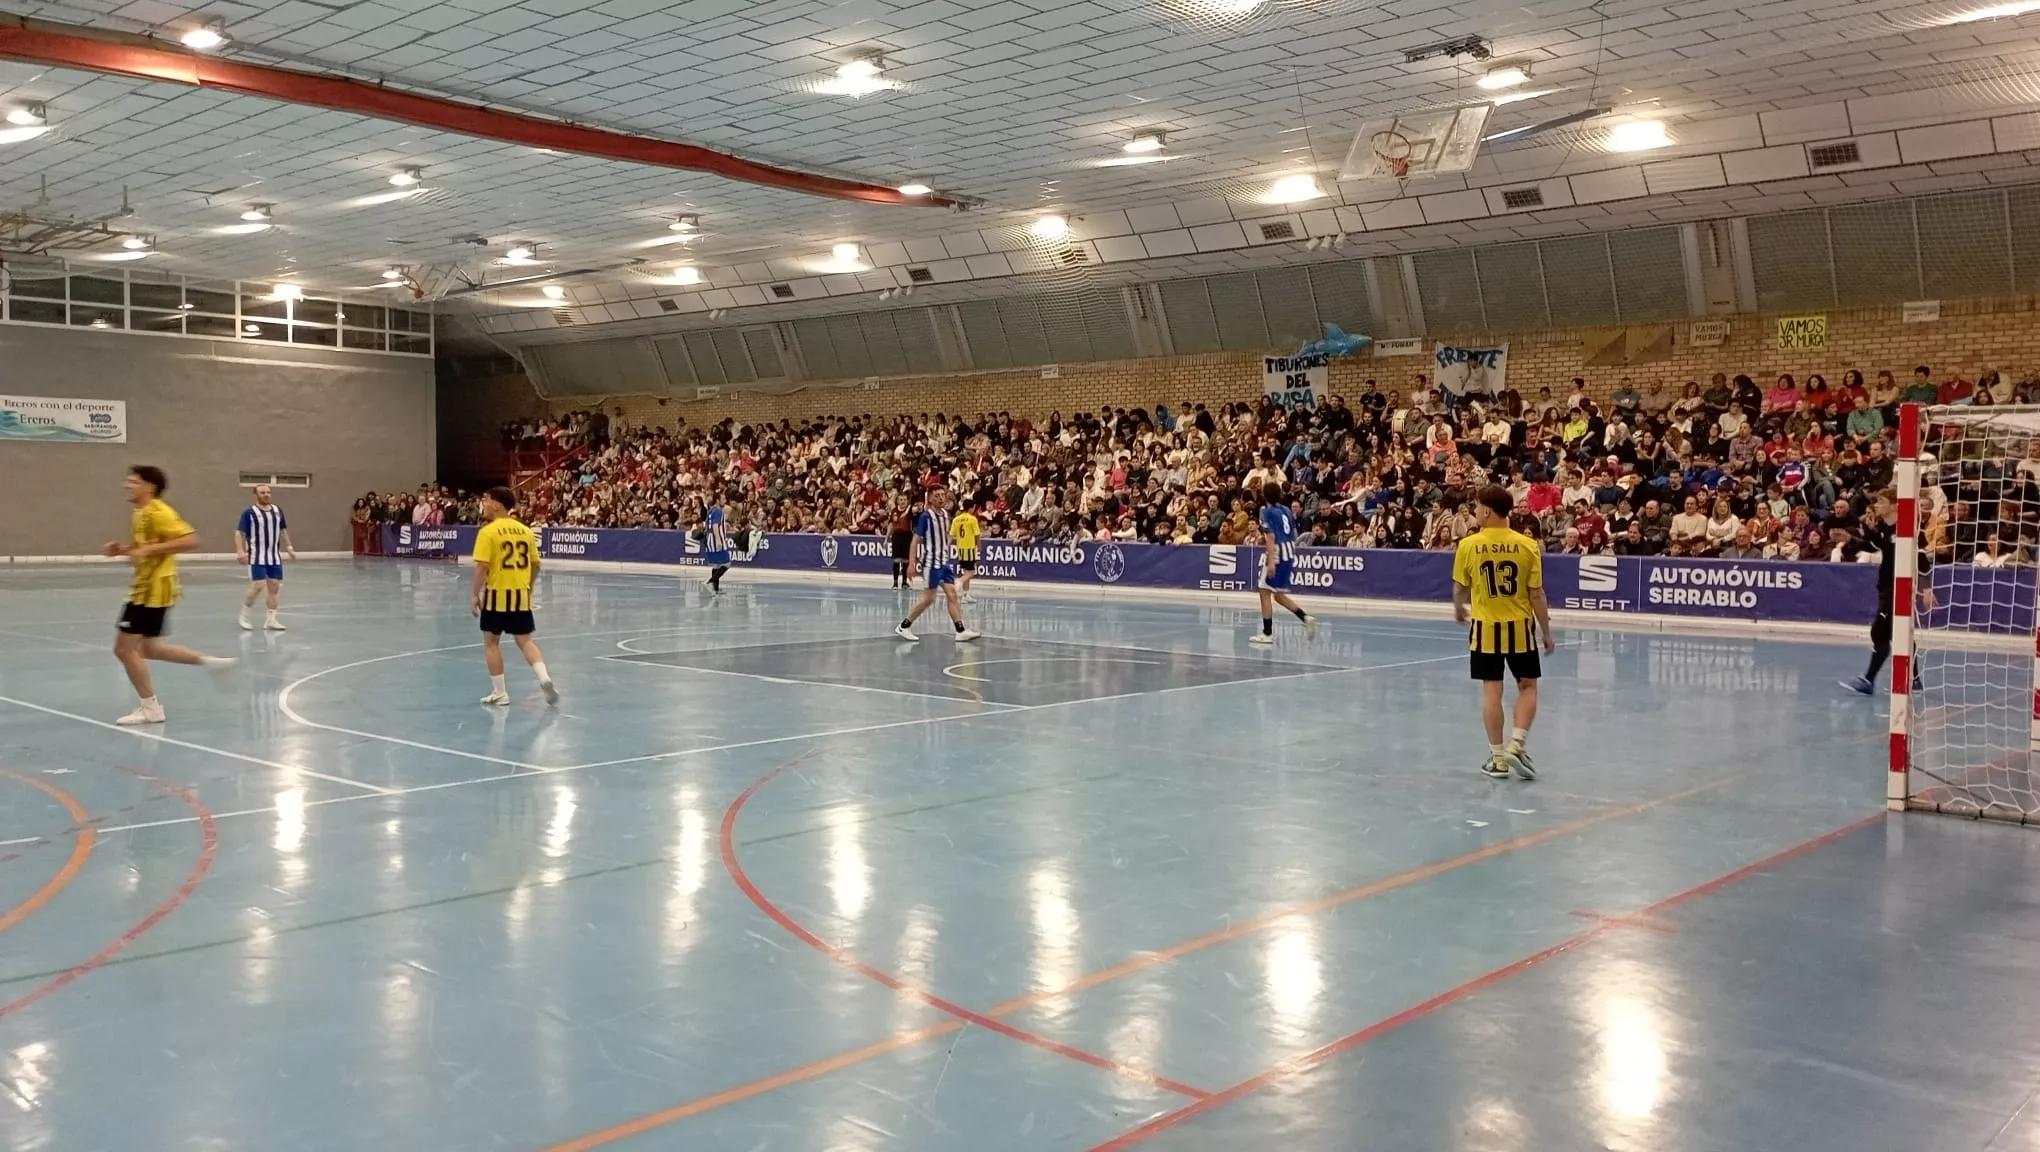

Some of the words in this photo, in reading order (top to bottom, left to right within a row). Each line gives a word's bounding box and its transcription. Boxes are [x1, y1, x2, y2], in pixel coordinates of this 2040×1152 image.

[1780, 319, 1824, 335] VAMOS
[1286, 372, 1310, 389] DEL
[40, 402, 59, 410] con
[63, 401, 72, 411] el
[75, 401, 115, 413] deporte
[20, 413, 56, 425] Ercros
[960, 523, 966, 538] 6
[1281, 514, 1290, 535] 8
[551, 530, 598, 543] AUTOMÓVILES
[501, 541, 529, 569] 23
[551, 544, 585, 555] SERRABLO
[851, 541, 893, 557] TORNE
[1475, 543, 1489, 554] LA
[1491, 543, 1520, 554] SALA
[679, 557, 706, 565] SEAT
[992, 565, 1017, 577] SALA
[1649, 565, 1803, 589] AUTOMÓVILES
[1199, 580, 1246, 590] SEAT
[1480, 560, 1519, 598] 13
[1565, 597, 1630, 610] SEAT
[1649, 587, 1757, 608] SERRABLO
